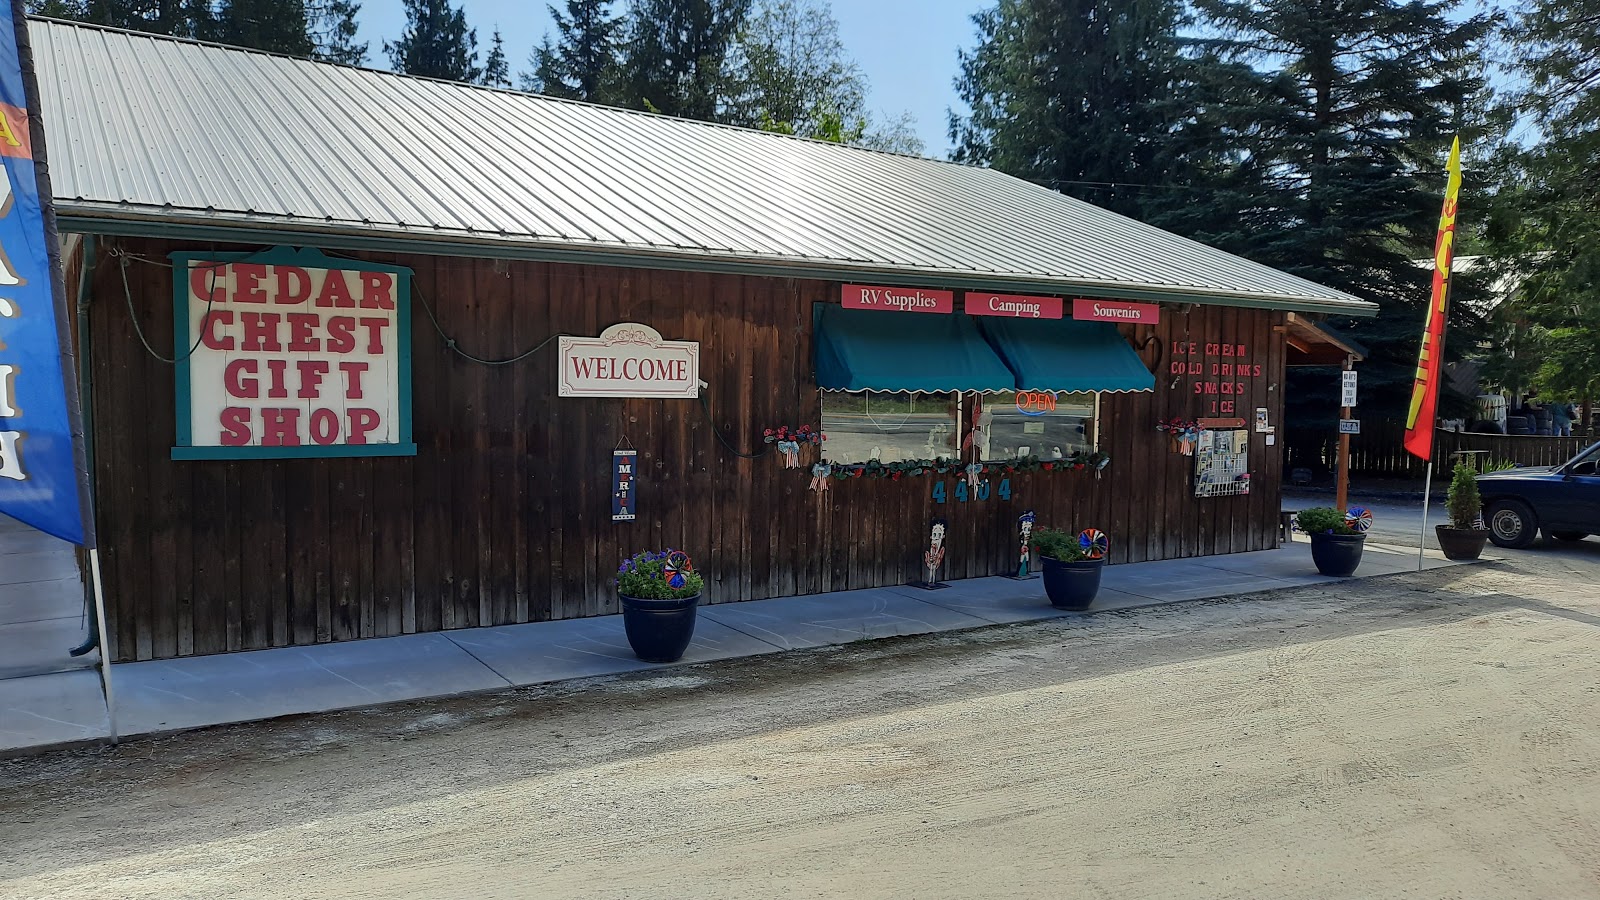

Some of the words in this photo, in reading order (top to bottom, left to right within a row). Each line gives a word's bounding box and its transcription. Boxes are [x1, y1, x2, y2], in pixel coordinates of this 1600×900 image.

[191, 261, 395, 310] CEDAR
[860, 288, 881, 306] RV
[884, 290, 937, 312] Supplies
[989, 296, 1041, 317] Camping
[1093, 303, 1141, 319] Souvenirs
[200, 310, 390, 355] CHEST
[1173, 342, 1196, 354] ICE
[1205, 343, 1246, 357] CREAM
[224, 359, 369, 399] GIFT
[571, 356, 688, 381] WELCOME
[1170, 361, 1203, 375] COLD
[1212, 363, 1261, 377] DRINKS
[1194, 381, 1244, 395] SNACKS
[1015, 391, 1057, 412] OPEN
[1211, 400, 1235, 413] ICE
[220, 406, 381, 446] SHOP
[618, 456, 632, 515] AMERICA
[932, 479, 1012, 504] 4404
